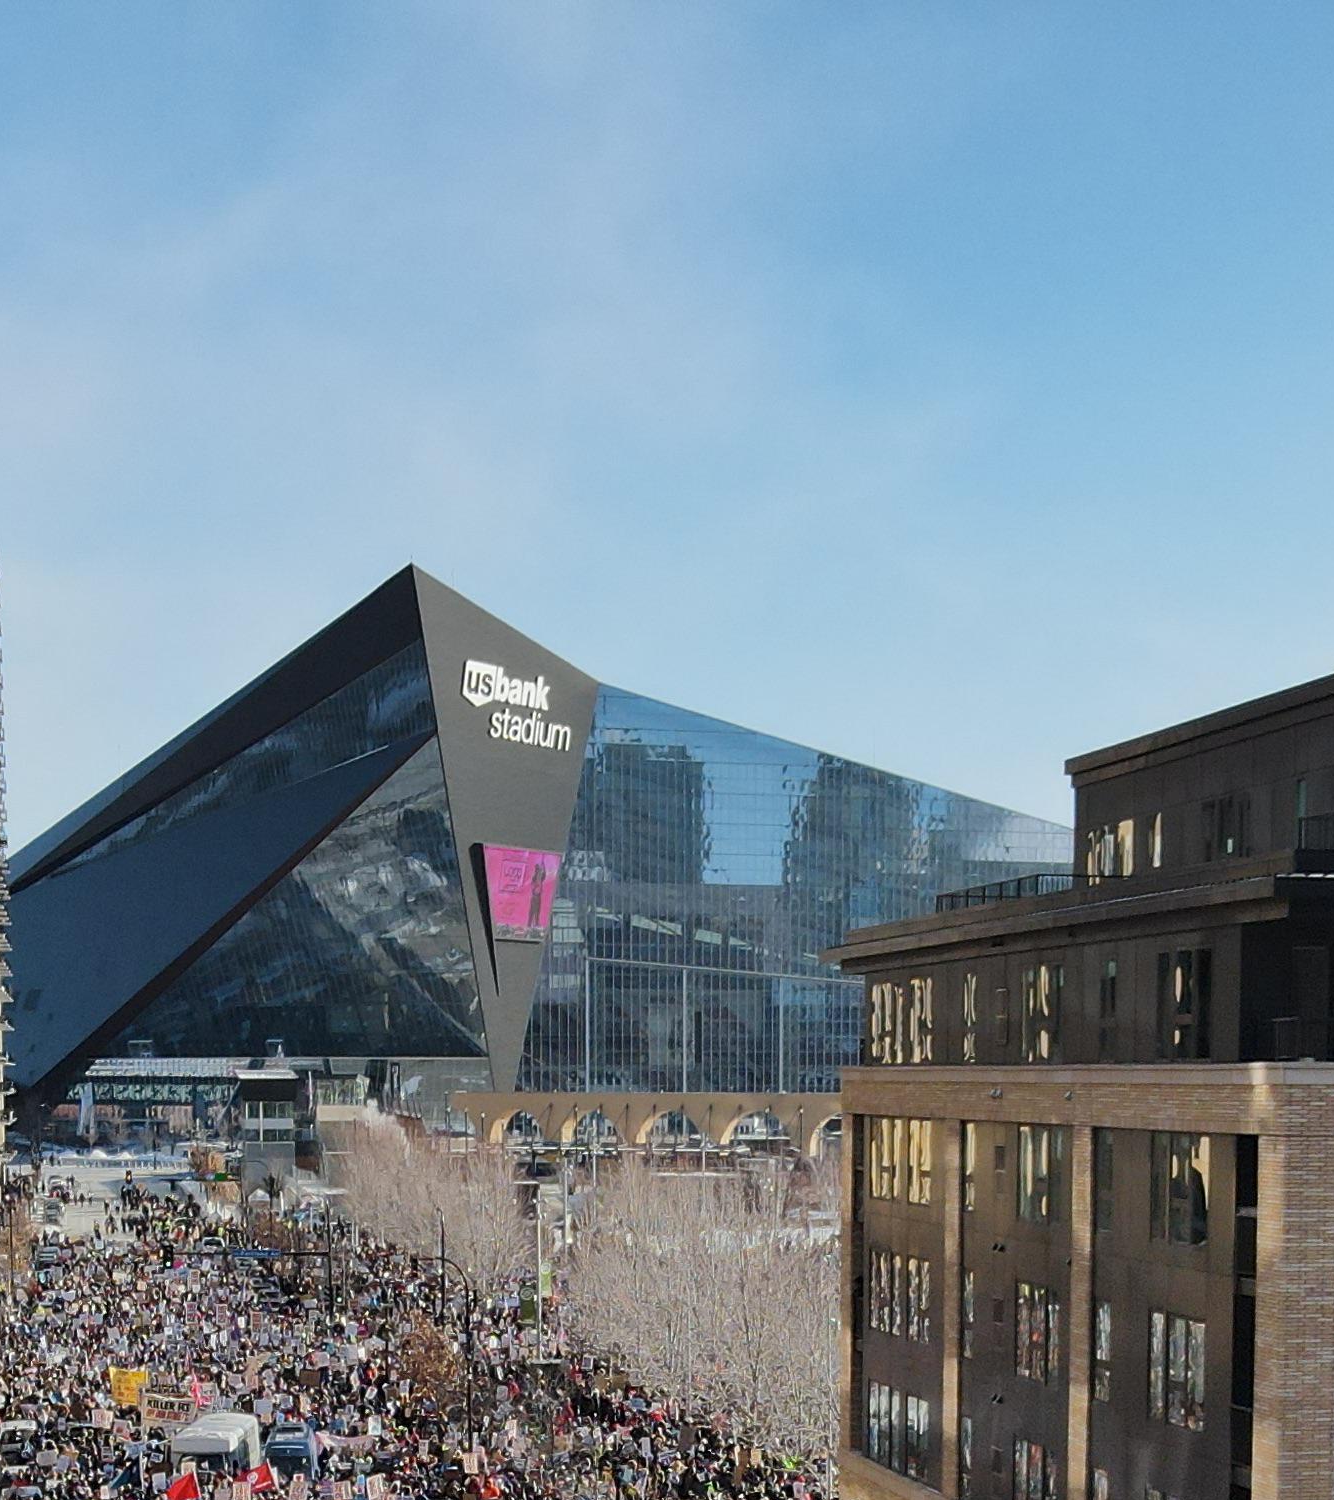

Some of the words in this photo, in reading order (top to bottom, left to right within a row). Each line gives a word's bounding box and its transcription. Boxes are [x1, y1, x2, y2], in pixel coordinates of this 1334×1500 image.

[466, 672, 493, 697] us
[495, 667, 550, 711] bank
[490, 711, 572, 751] stadium
